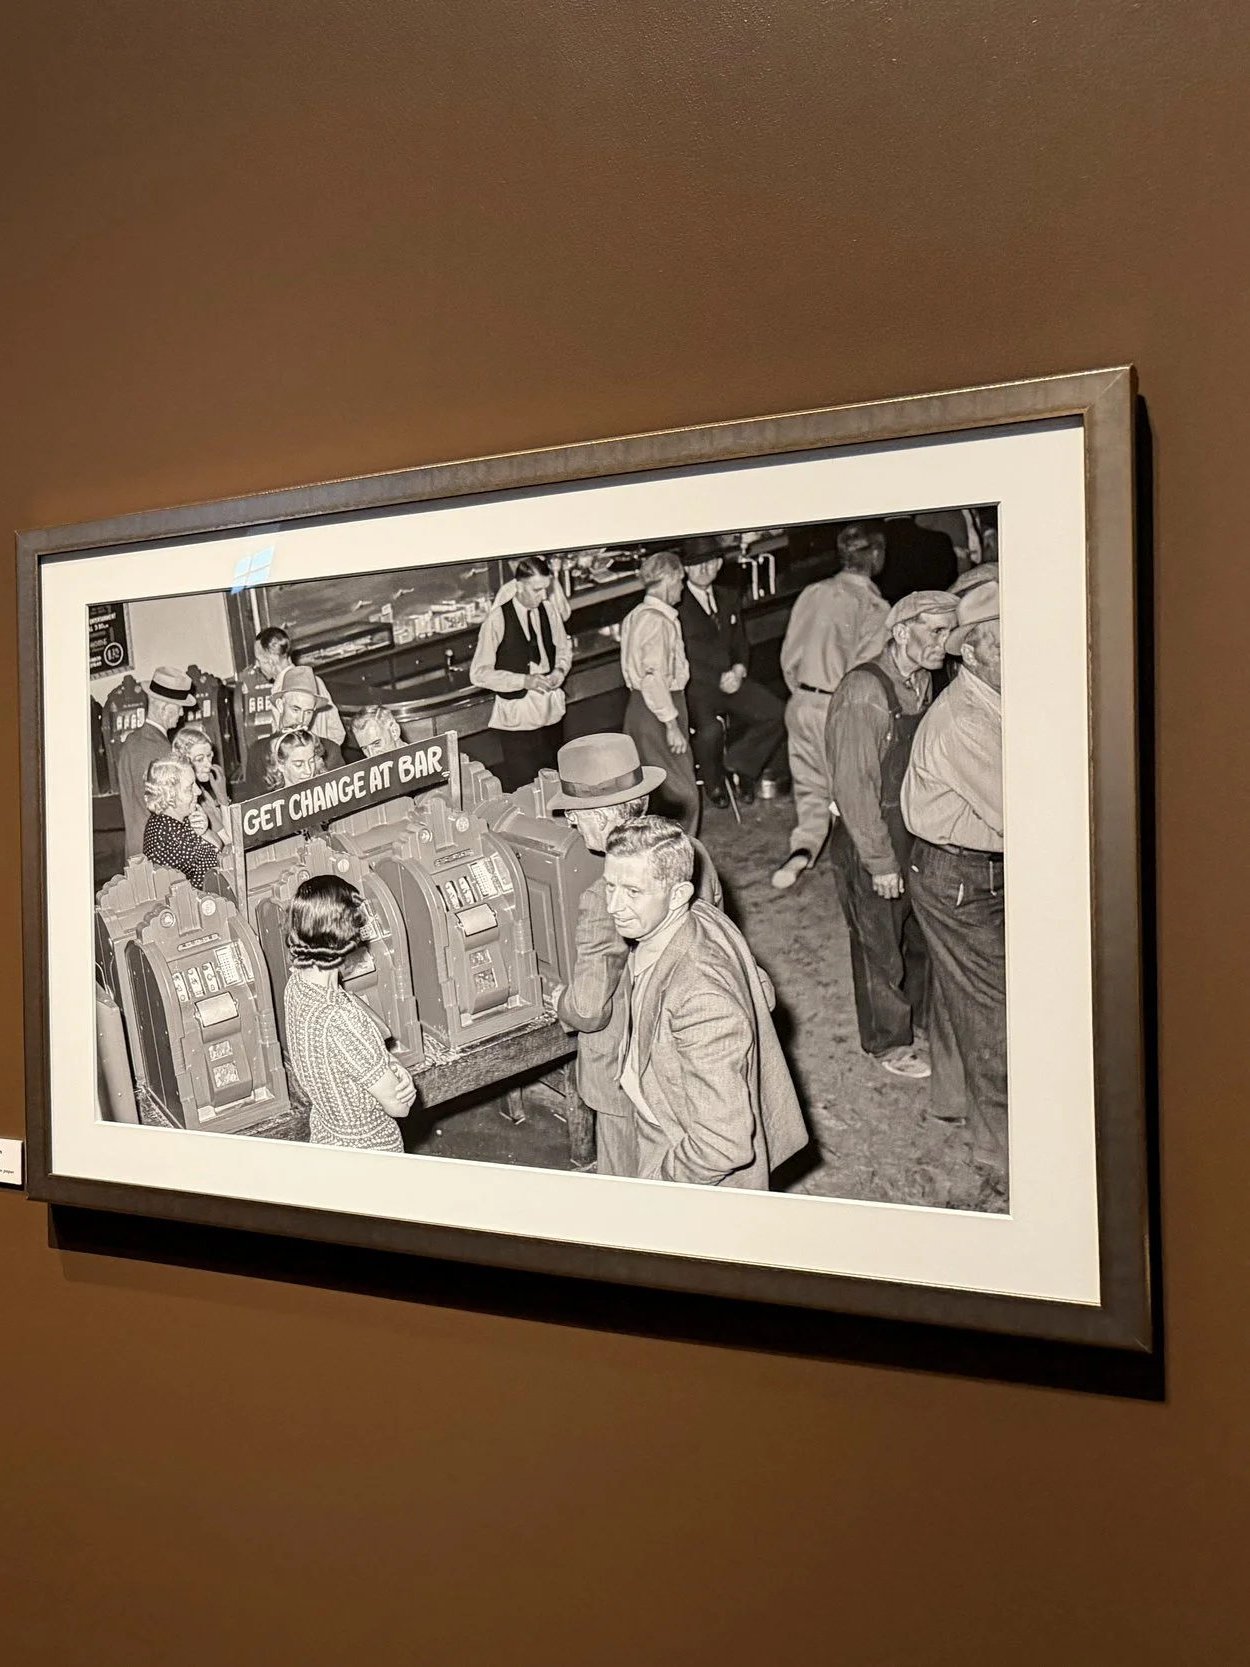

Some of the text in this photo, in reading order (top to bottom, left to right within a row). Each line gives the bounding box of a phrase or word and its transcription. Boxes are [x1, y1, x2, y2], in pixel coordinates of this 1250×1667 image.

[243, 745, 444, 836] GET CHANGE AT BAR
